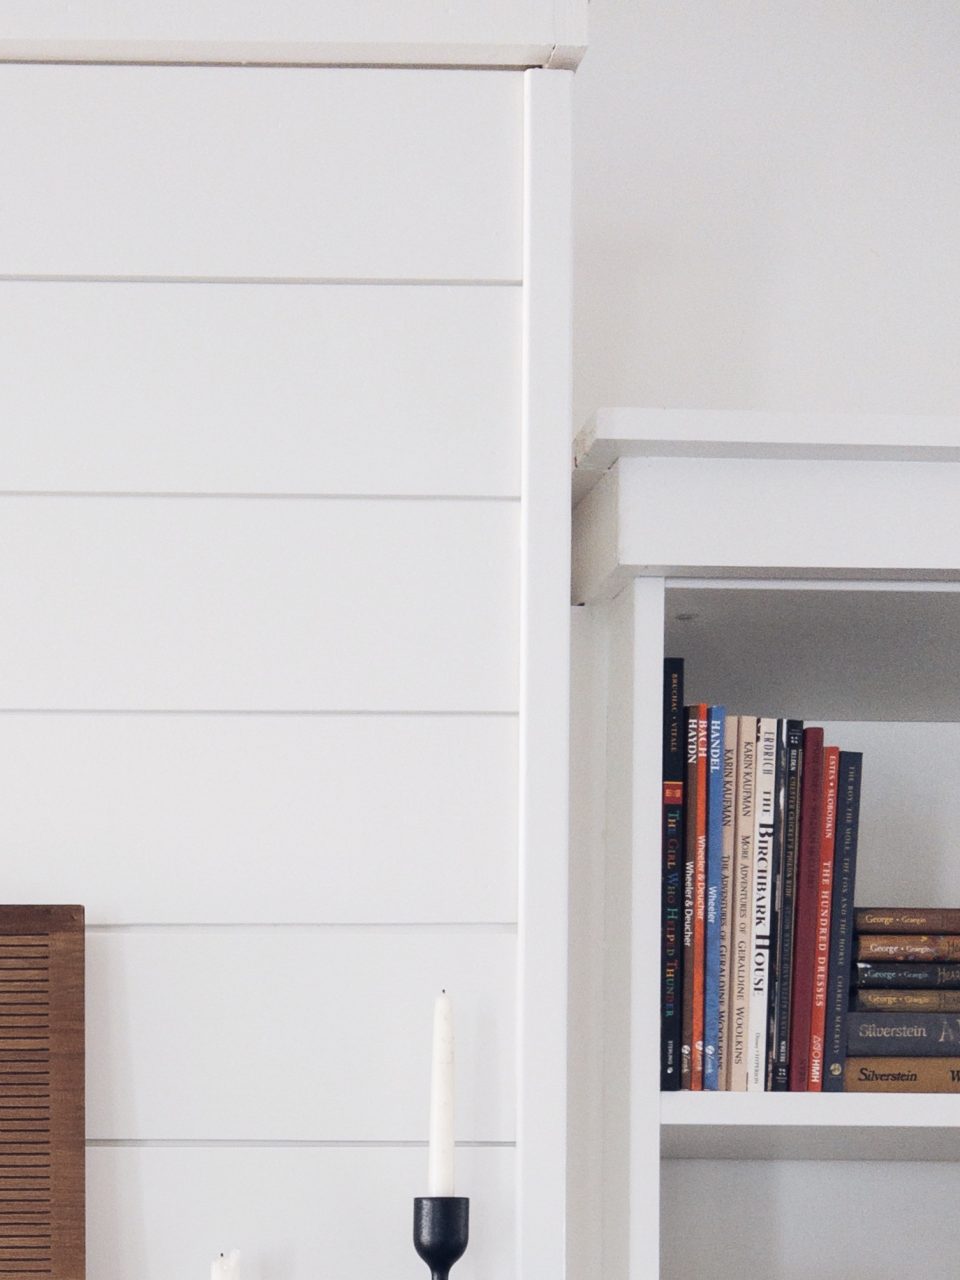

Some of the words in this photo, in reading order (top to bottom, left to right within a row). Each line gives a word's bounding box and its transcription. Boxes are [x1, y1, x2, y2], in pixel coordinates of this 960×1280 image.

[688, 719, 696, 764] HAYDN
[699, 720, 707, 757] BACH
[710, 720, 720, 773] HANDEL
[744, 742, 754, 769] KARIN
[763, 732, 775, 774] ERDRICH
[723, 749, 734, 778] KARIN
[722, 780, 733, 826] KAUFMAN
[743, 772, 753, 816] KAUFMAN
[762, 791, 772, 814] THE
[788, 777, 796, 808] CHESTER
[668, 811, 679, 834] THE
[825, 789, 834, 838] SLOBODKIN
[667, 841, 678, 868] GIRL
[741, 835, 750, 860] MORE
[786, 852, 794, 877] PIGEON
[667, 873, 678, 903] WHO
[685, 862, 693, 898] Wheeler
[755, 823, 774, 926] BIRCHBARK
[822, 861, 831, 884] THE
[697, 883, 705, 920] Deucher
[708, 886, 717, 923] Wheeler
[720, 874, 729, 926] ADVENTURES
[739, 865, 749, 918] ADVENTURES
[666, 908, 678, 956] HELPED
[684, 909, 692, 946] Deucher
[738, 923, 746, 934] OF
[818, 891, 828, 950] HUNDRED
[865, 914, 894, 926] George
[753, 934, 770, 996] HOUSE
[838, 939, 846, 966] HORSE
[870, 944, 899, 955] George
[666, 960, 678, 1016] THUNDER
[718, 945, 727, 1006] GERALDINE
[736, 940, 746, 1000] GERALDINE
[816, 956, 826, 1007] DRESSES
[867, 970, 897, 980] George
[867, 994, 898, 1006] George
[735, 1008, 745, 1064] WOOLKINS
[858, 1023, 928, 1038] Silverstein
[811, 1059, 820, 1082] HMH
[858, 1067, 919, 1082] Silverstein
